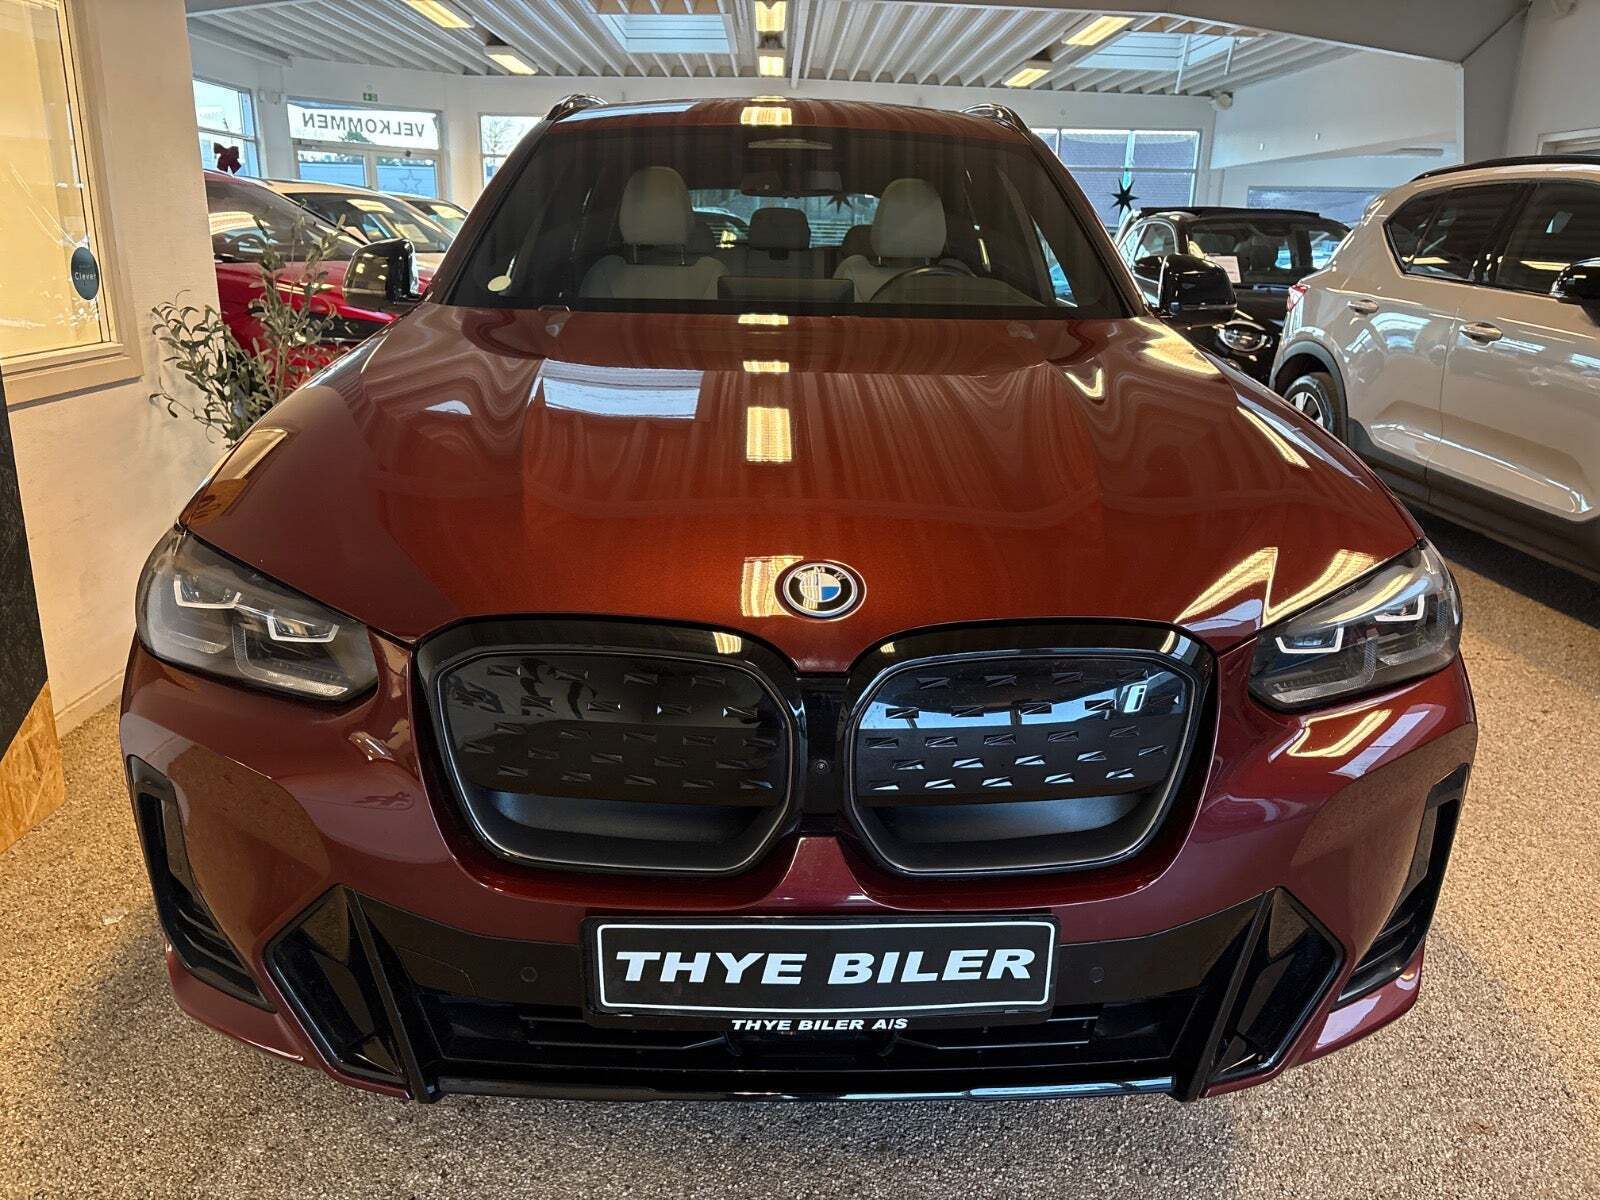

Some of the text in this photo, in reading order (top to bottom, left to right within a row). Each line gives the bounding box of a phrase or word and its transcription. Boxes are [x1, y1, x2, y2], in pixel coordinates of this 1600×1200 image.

[74, 271, 97, 281] Clever
[616, 949, 1036, 985] THYE BILER
[731, 1018, 908, 1031] THYE BILER A/S
